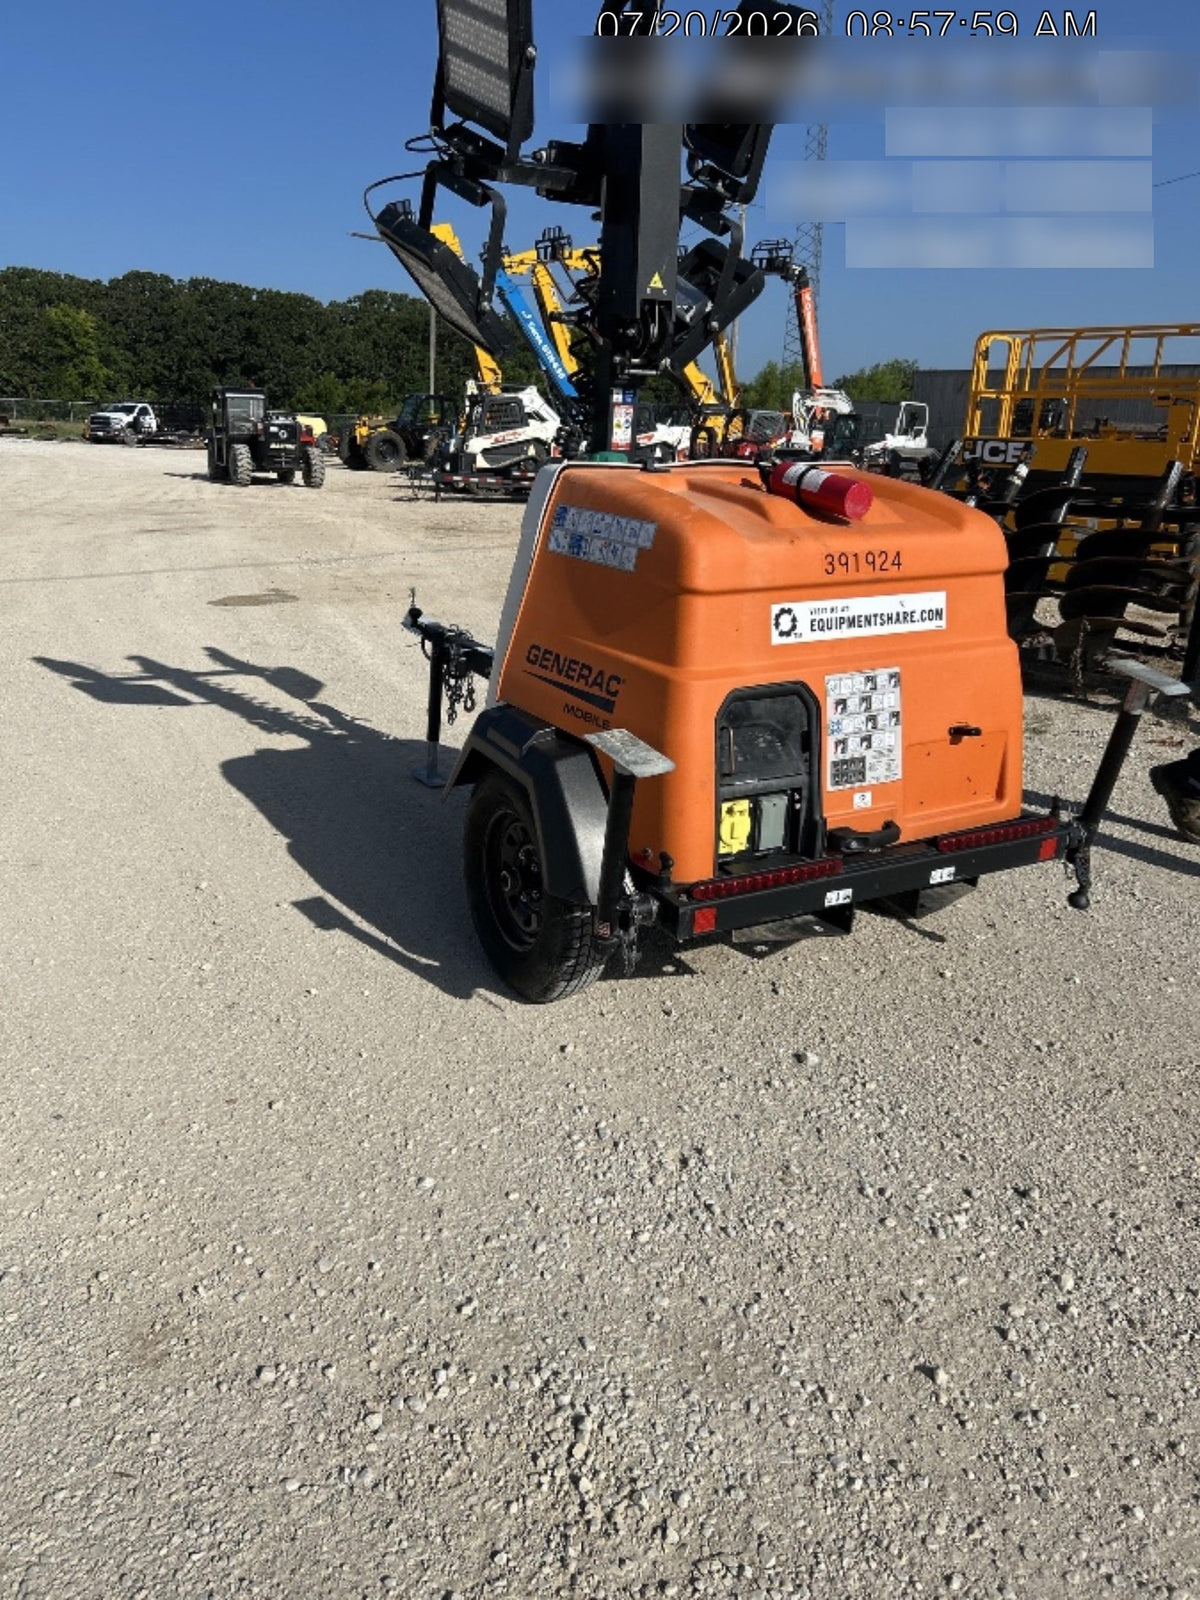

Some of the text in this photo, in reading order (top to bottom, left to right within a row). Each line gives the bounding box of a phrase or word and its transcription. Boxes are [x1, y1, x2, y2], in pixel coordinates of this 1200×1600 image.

[824, 550, 902, 575] 391924
[810, 607, 944, 632] EQUIPMENTSHARE.COM
[526, 644, 622, 698] GENERAC
[563, 703, 611, 730] MOBILE
